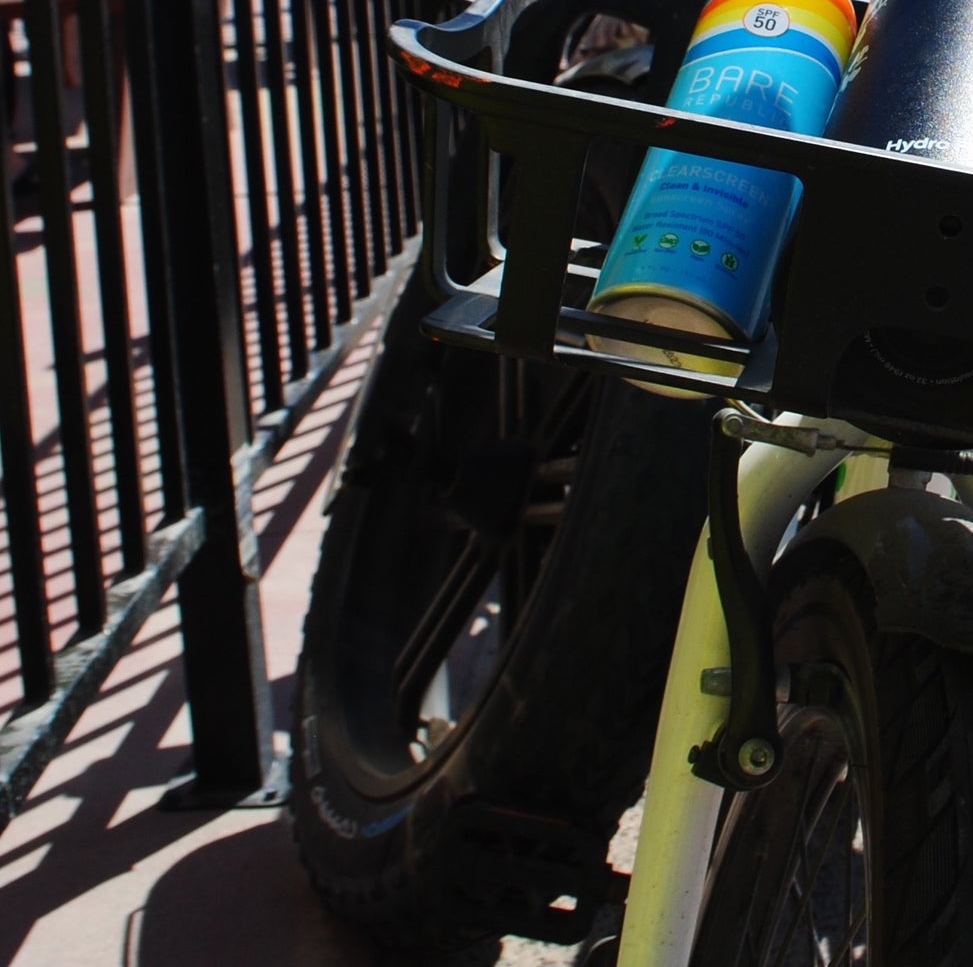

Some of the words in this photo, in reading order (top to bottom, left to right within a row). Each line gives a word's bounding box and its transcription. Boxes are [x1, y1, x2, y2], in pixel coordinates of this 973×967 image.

[757, 8, 780, 18] SPF
[753, 16, 777, 31] 50
[688, 65, 799, 117] BARE
[886, 138, 950, 153] Hydro
[660, 182, 688, 191] Clean
[691, 182, 701, 191] &
[703, 183, 749, 209] Invisible
[670, 210, 718, 225] Spectrum
